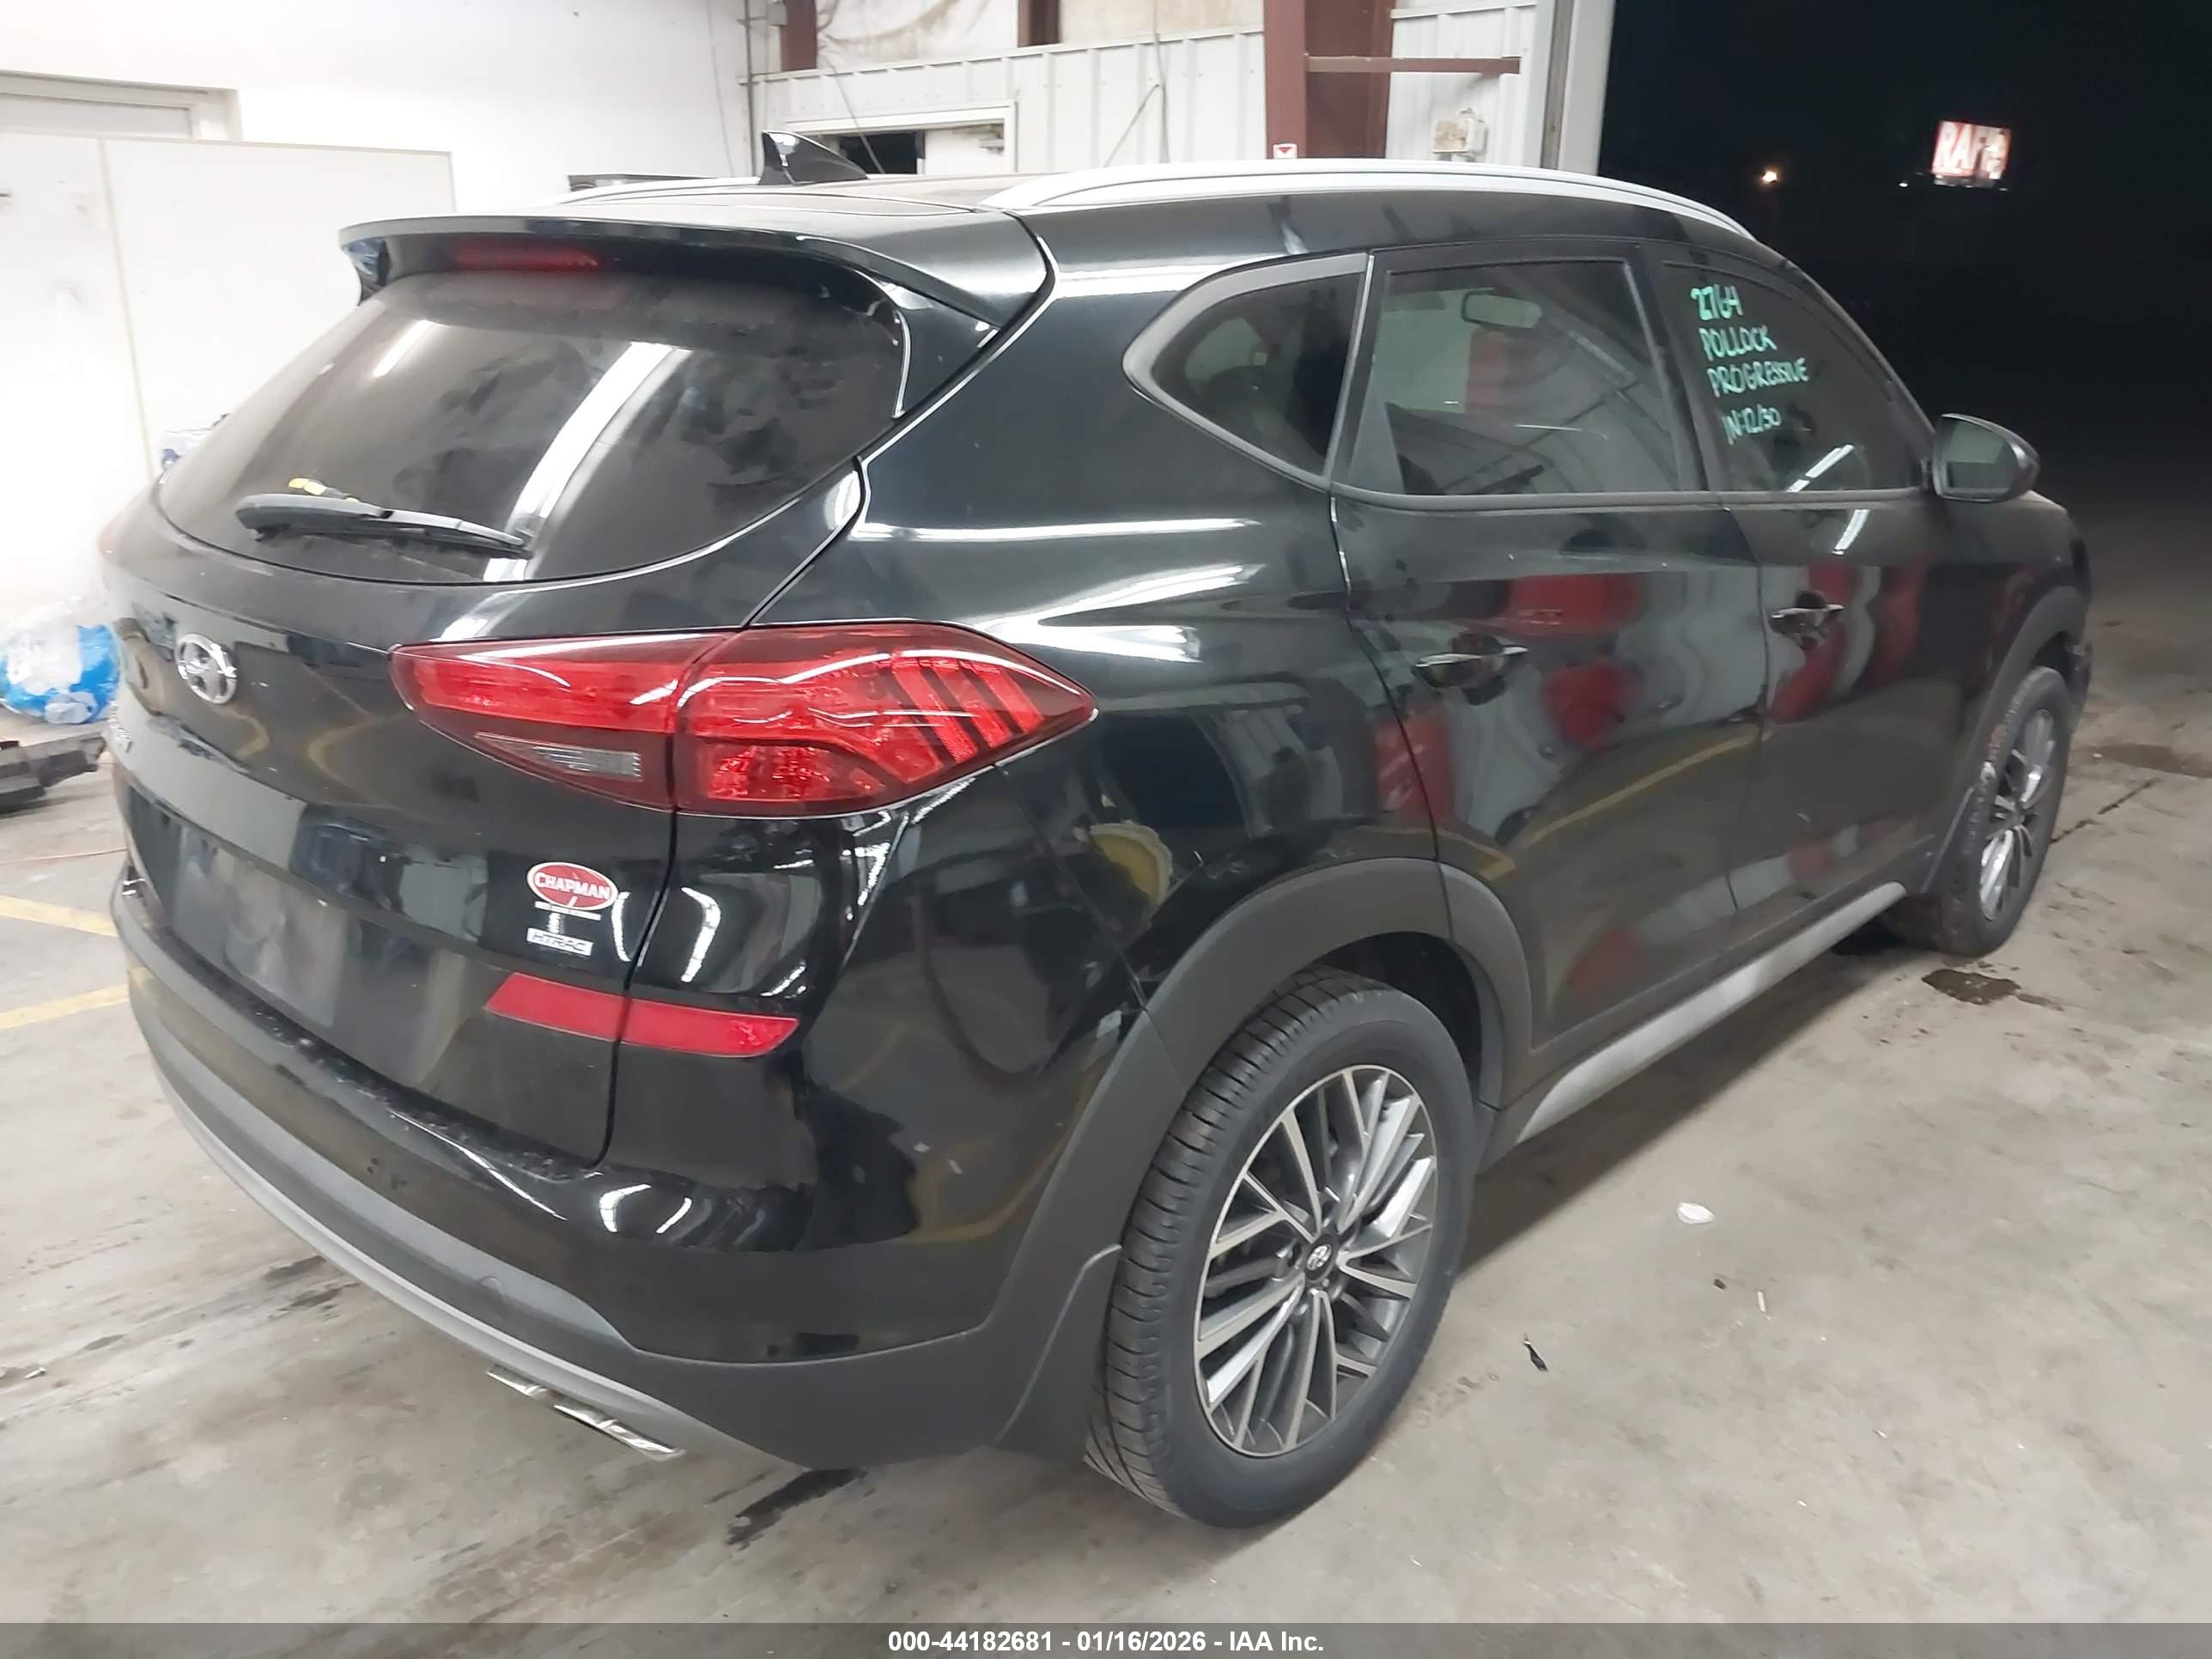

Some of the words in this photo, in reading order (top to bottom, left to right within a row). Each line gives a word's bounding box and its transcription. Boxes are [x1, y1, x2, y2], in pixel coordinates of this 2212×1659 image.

[1690, 284, 1743, 320] 2764
[1698, 325, 1778, 362] POLLOCK
[1706, 357, 1810, 398] PROGRESSIVE
[534, 872, 611, 900] CHAPMAN
